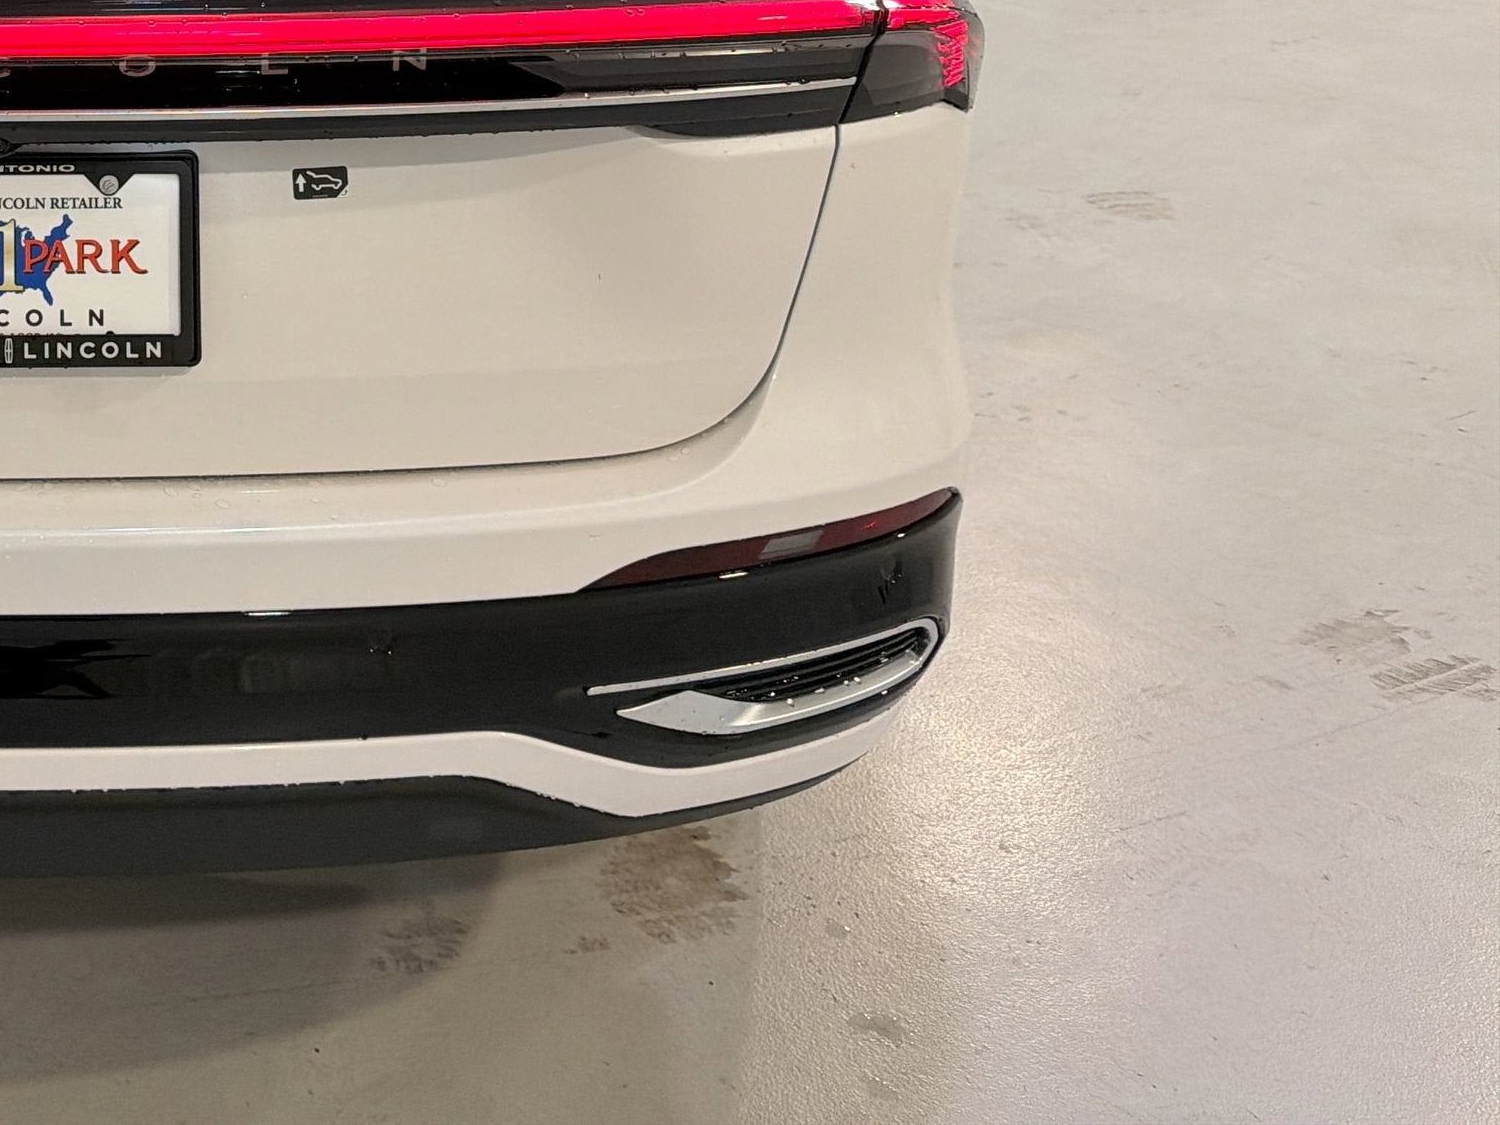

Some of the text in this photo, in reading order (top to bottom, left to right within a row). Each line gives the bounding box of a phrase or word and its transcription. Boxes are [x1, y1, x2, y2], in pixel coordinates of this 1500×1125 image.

[50, 197, 123, 210] RETAILER
[23, 239, 148, 275] PARK
[23, 342, 162, 359] LINCOLN
